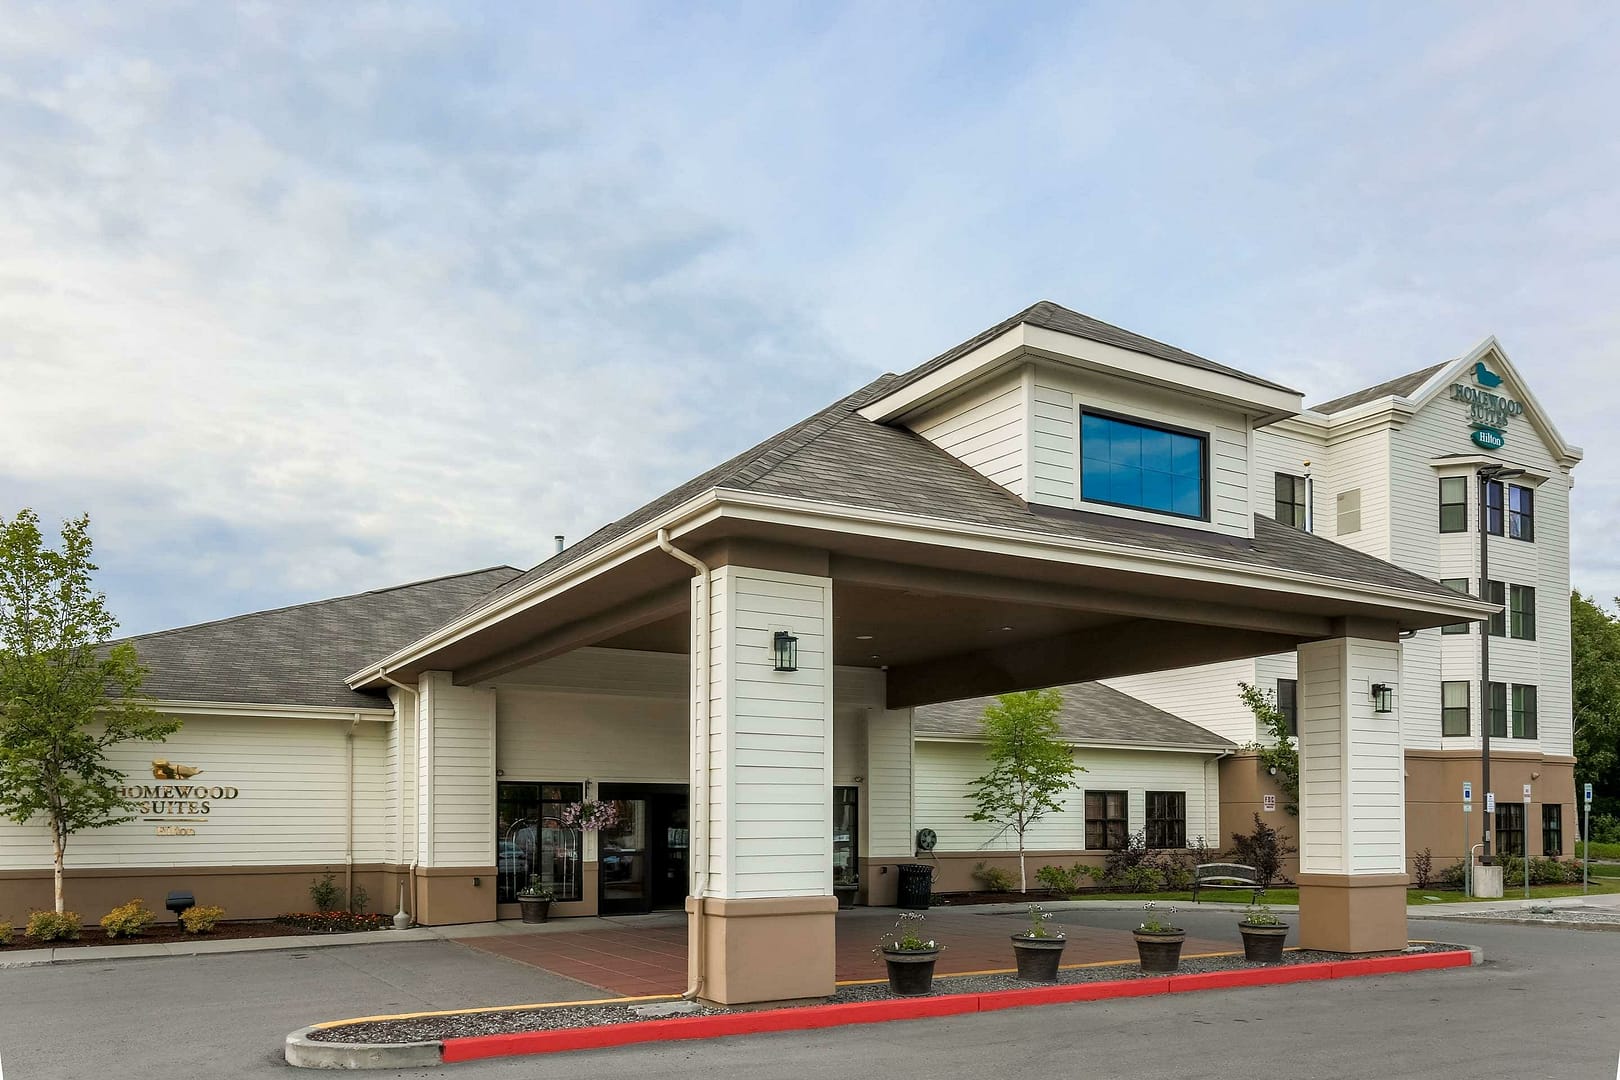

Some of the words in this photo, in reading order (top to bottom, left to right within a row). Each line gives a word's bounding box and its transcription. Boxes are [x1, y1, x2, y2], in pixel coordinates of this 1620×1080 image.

[1452, 384, 1523, 415] HOMEWOOD
[1469, 402, 1508, 427] SUITES
[1480, 431, 1501, 446] Hilton
[140, 800, 210, 814] SUITES
